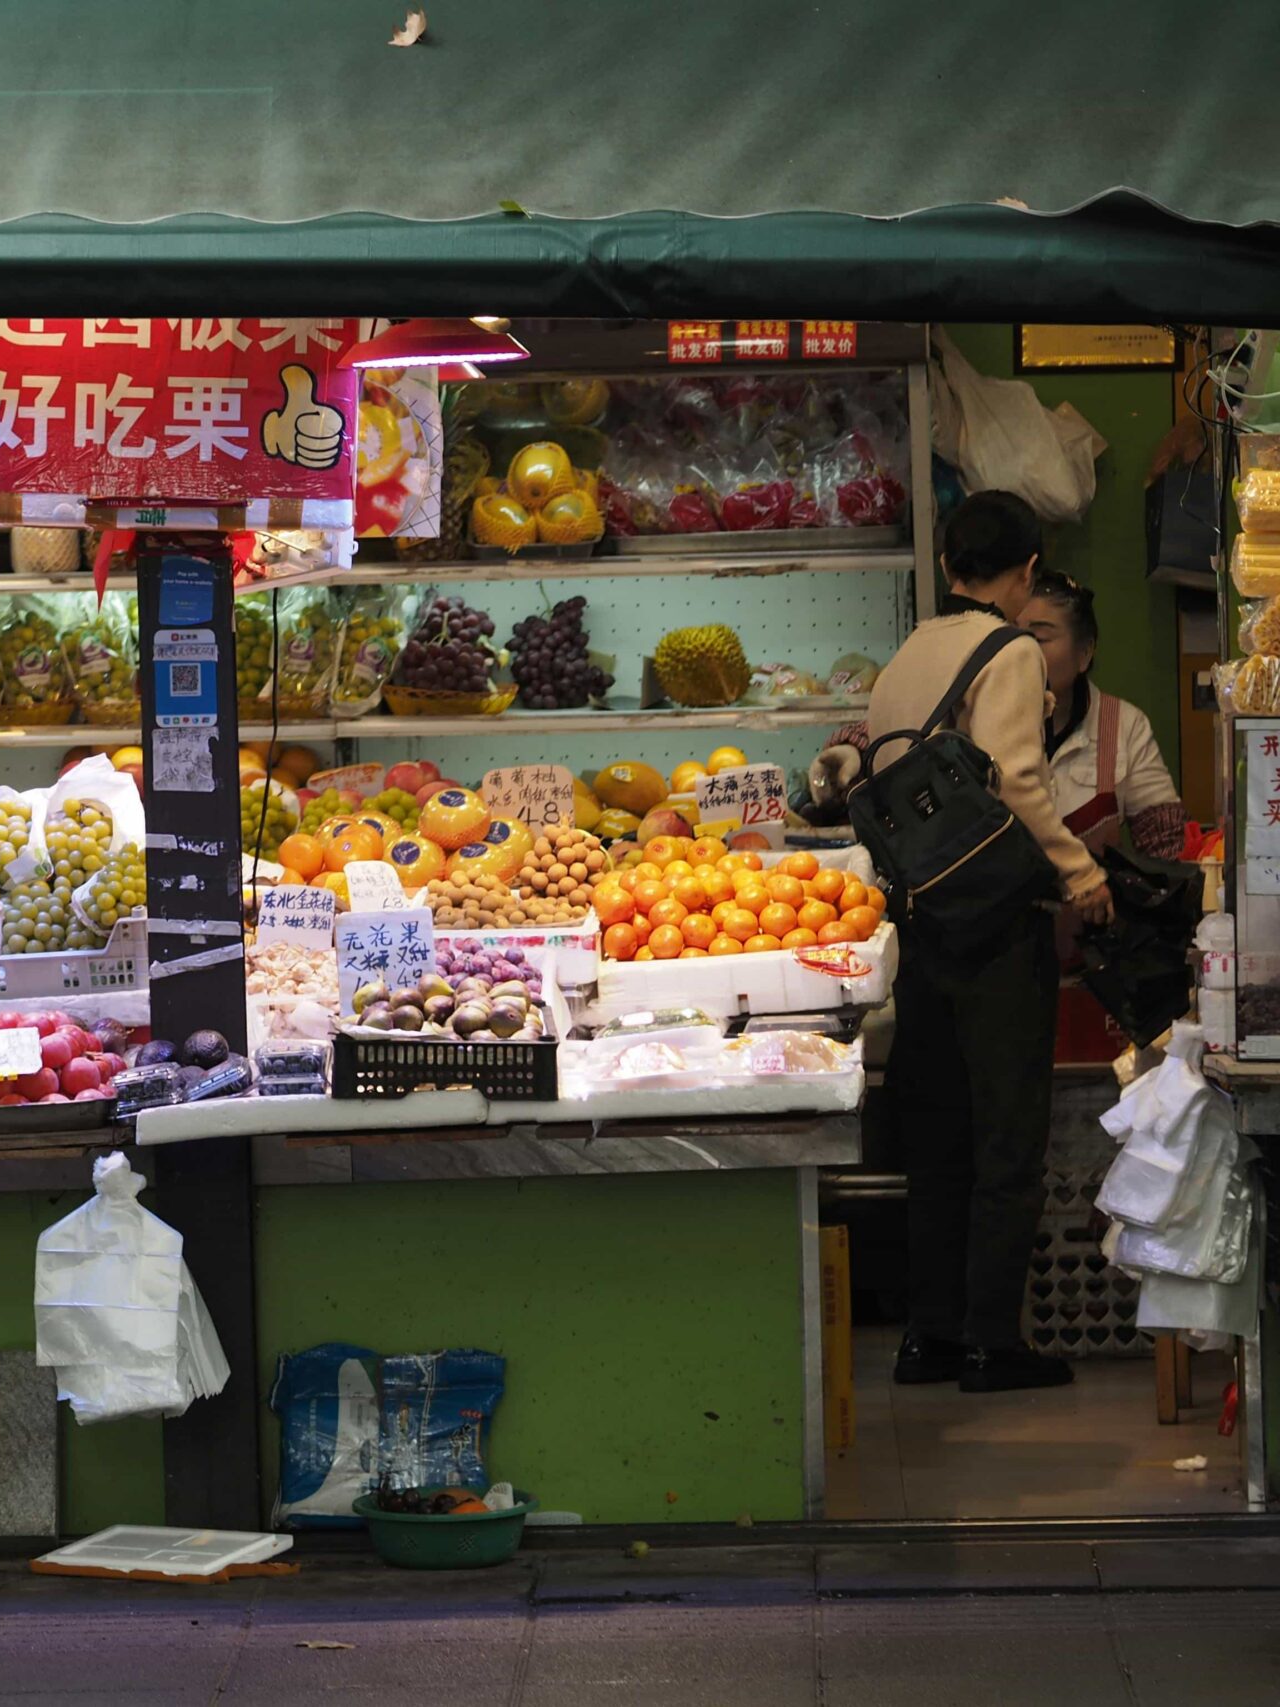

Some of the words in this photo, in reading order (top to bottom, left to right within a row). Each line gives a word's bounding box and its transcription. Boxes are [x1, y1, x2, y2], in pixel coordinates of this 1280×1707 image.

[672, 342, 719, 359] 批发价
[738, 340, 786, 356] 批发价
[805, 338, 853, 354] 批发价
[342, 920, 422, 951] 无花果
